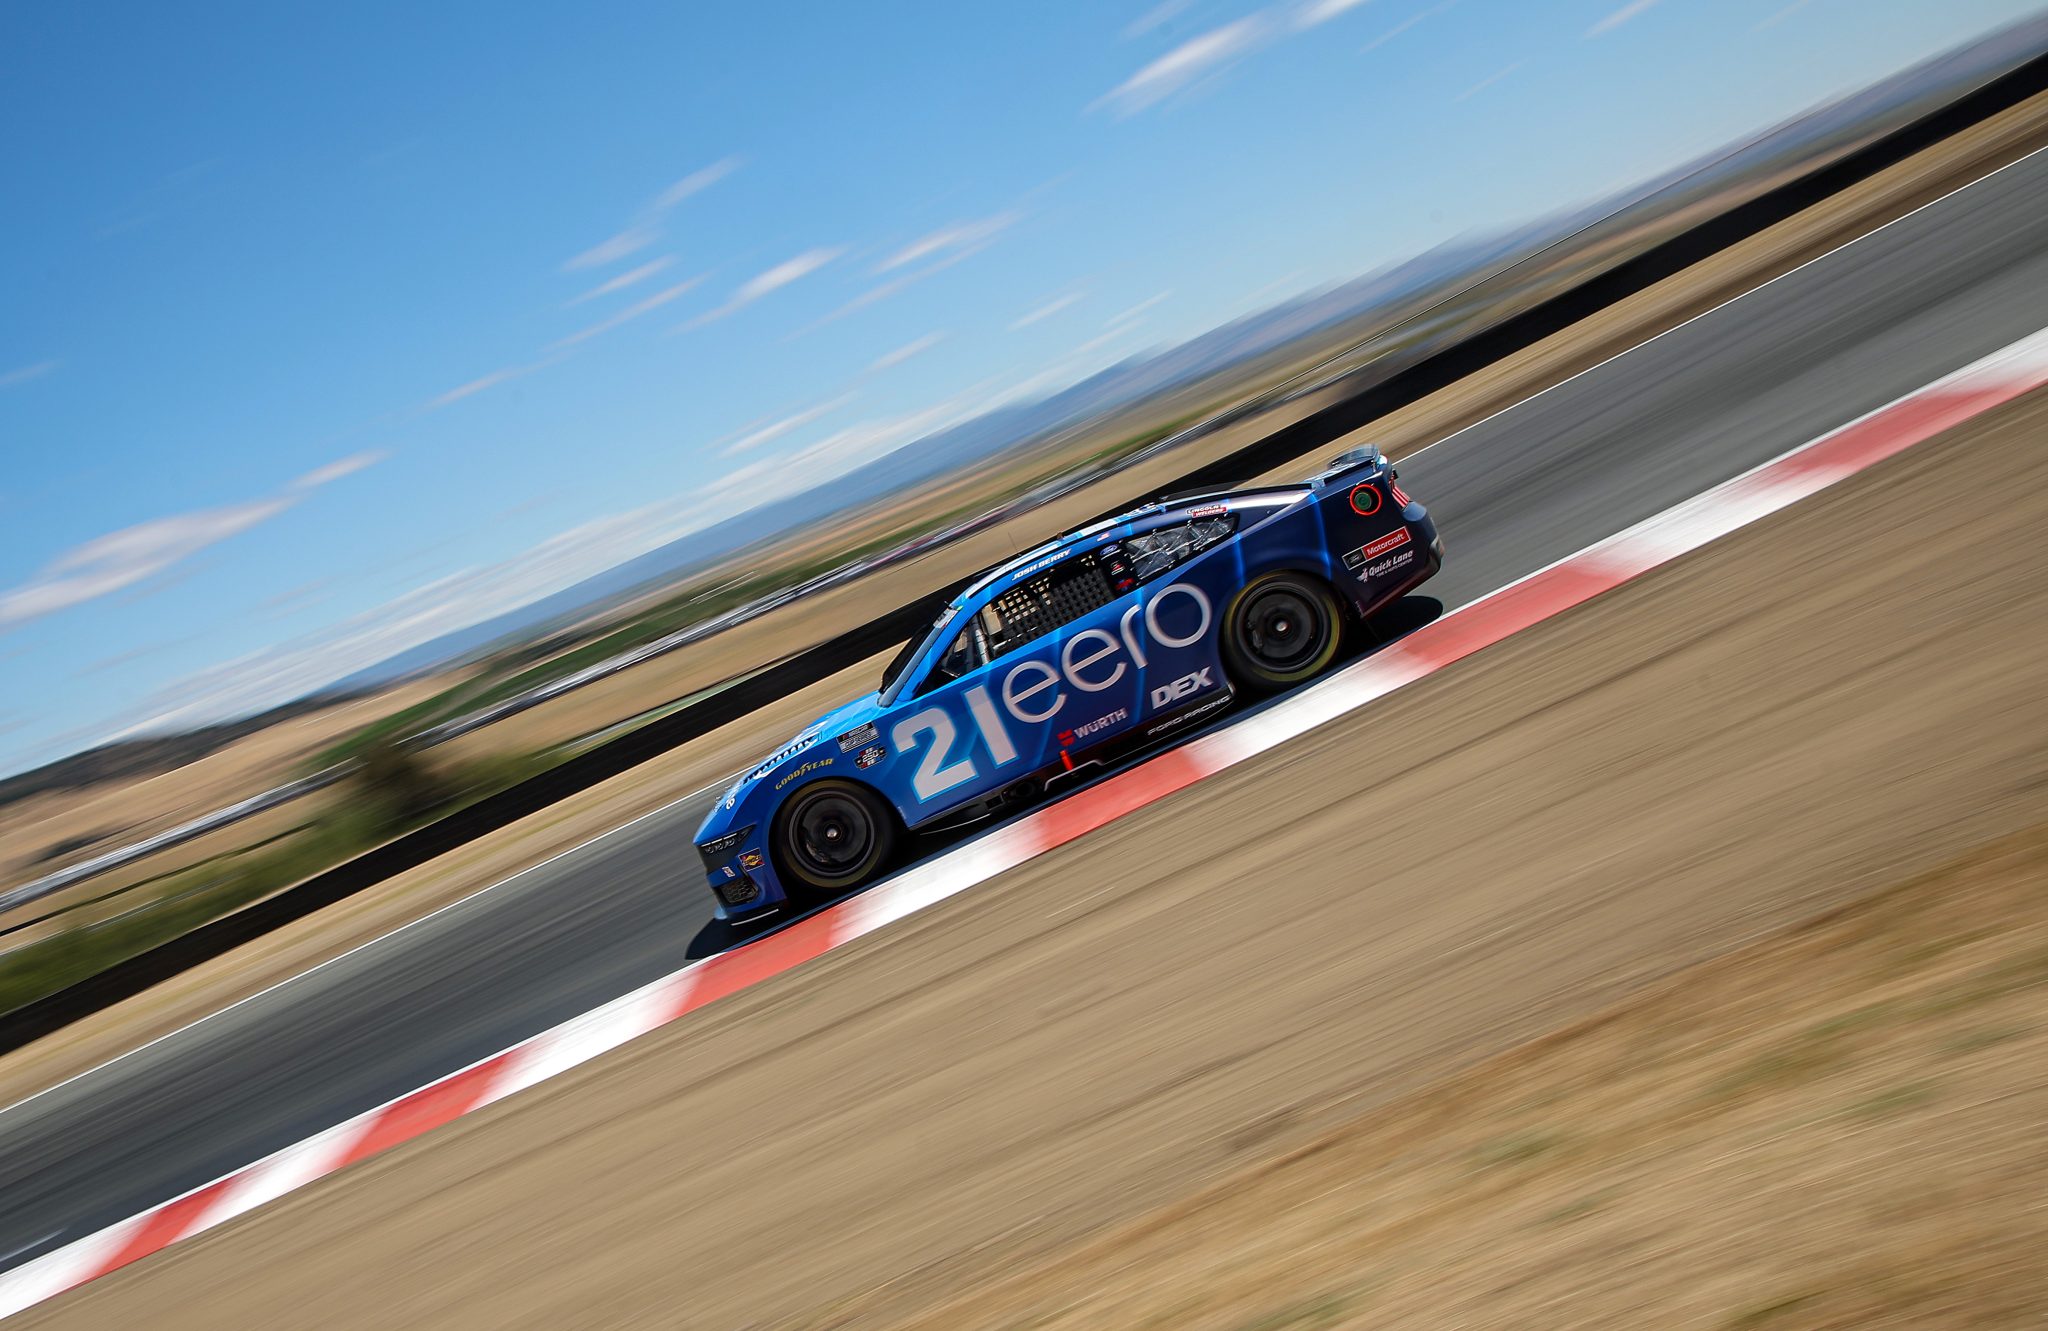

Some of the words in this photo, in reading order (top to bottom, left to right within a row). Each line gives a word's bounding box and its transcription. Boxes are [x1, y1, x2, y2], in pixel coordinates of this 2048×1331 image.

[1366, 533, 1406, 556] Motorcraft
[1011, 563, 1038, 581] JOSH
[1038, 548, 1072, 568] BERRY
[1368, 558, 1393, 577] Quick
[1393, 550, 1414, 566] Lane
[1002, 583, 1211, 723] eero
[1150, 665, 1214, 710] DEX
[1073, 707, 1129, 738] WÜRTH
[1147, 716, 1183, 735] FORD
[1183, 694, 1232, 719] RACING
[891, 685, 1020, 804] 21
[775, 758, 834, 791] GOODYEAR
